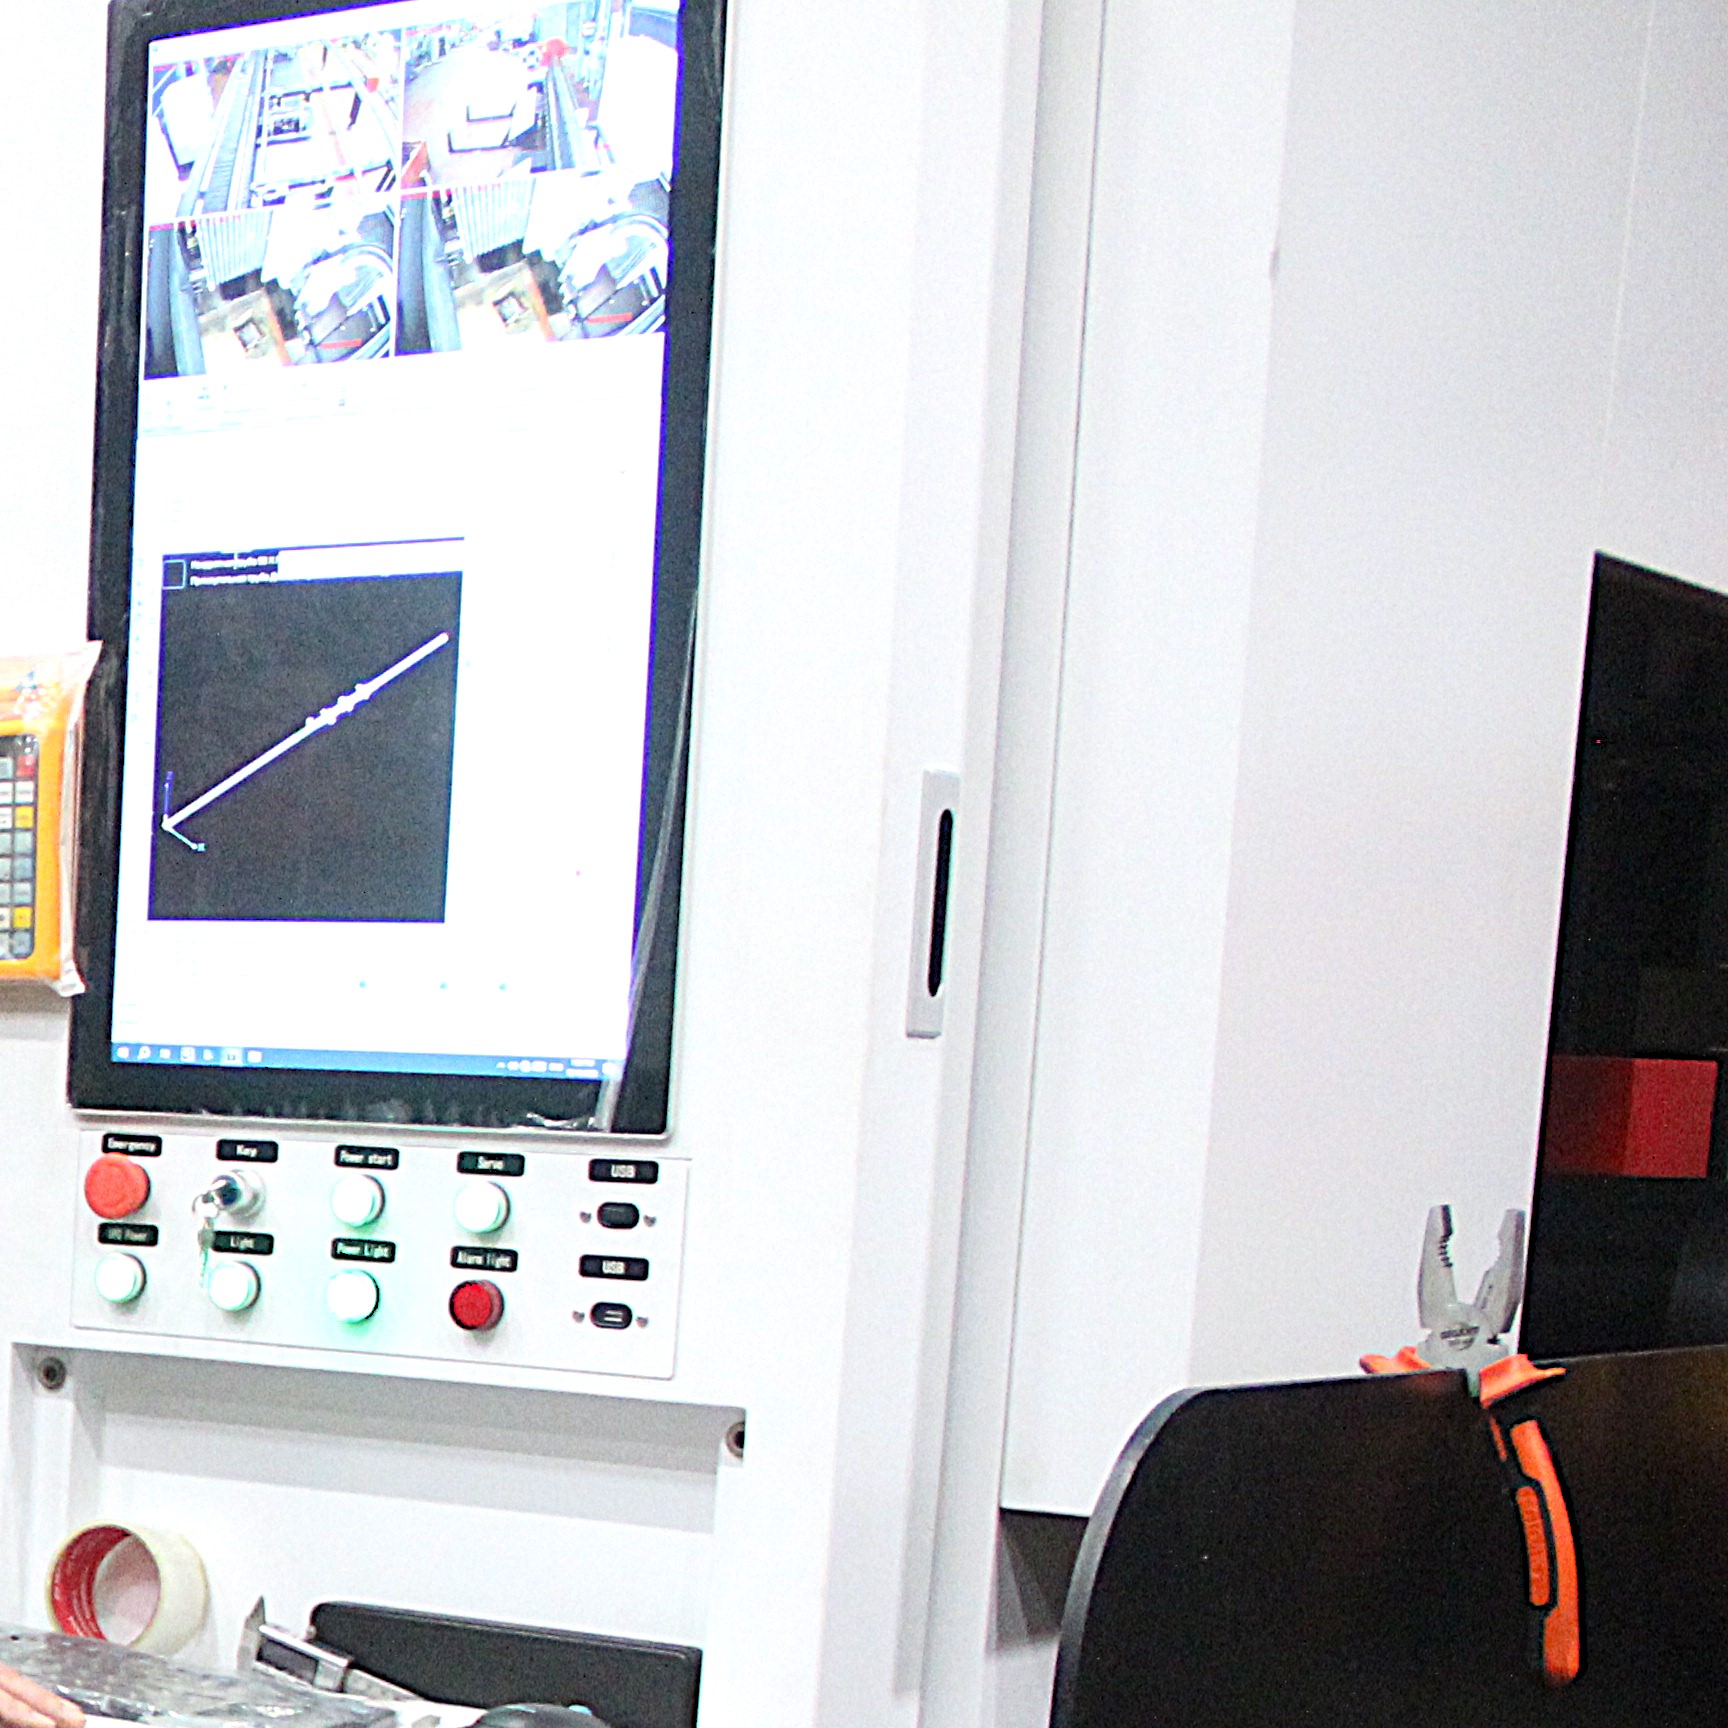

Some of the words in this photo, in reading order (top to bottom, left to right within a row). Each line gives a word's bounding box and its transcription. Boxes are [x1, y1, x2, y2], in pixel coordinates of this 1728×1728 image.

[108, 1138, 156, 1153] Emergency
[237, 1145, 257, 1158] Key
[341, 1150, 364, 1164] Power
[368, 1152, 392, 1166] start
[478, 1156, 504, 1170] Servo
[611, 1164, 636, 1178] USB
[230, 1236, 256, 1250] Light
[337, 1242, 361, 1255] Power
[364, 1243, 390, 1259] Light
[457, 1250, 483, 1265] Alarm
[602, 1261, 626, 1275] USB
